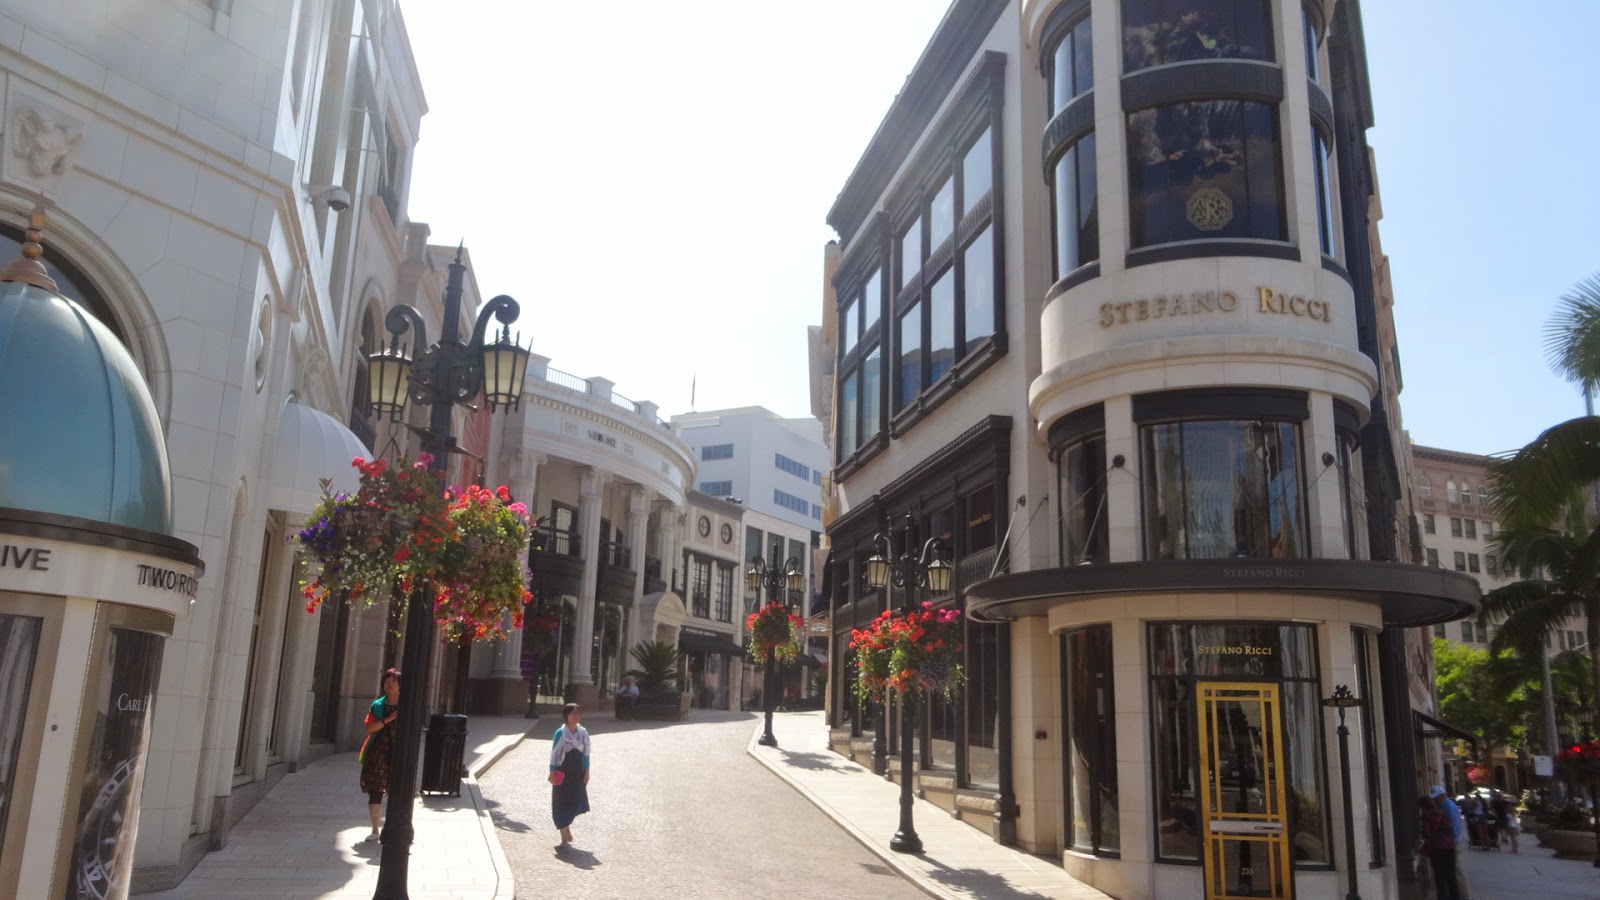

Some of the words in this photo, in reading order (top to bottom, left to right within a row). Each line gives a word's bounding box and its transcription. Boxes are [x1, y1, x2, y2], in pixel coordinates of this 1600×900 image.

[1098, 289, 1237, 328] STEFANO
[1256, 286, 1330, 322] RICCI
[139, 564, 177, 590] TWO
[1223, 567, 1273, 577] STEFANO
[1276, 567, 1305, 577] RICCI
[1198, 645, 1243, 655] STEFANO
[1245, 645, 1272, 656] RICCI
[1241, 867, 1254, 876] 270
